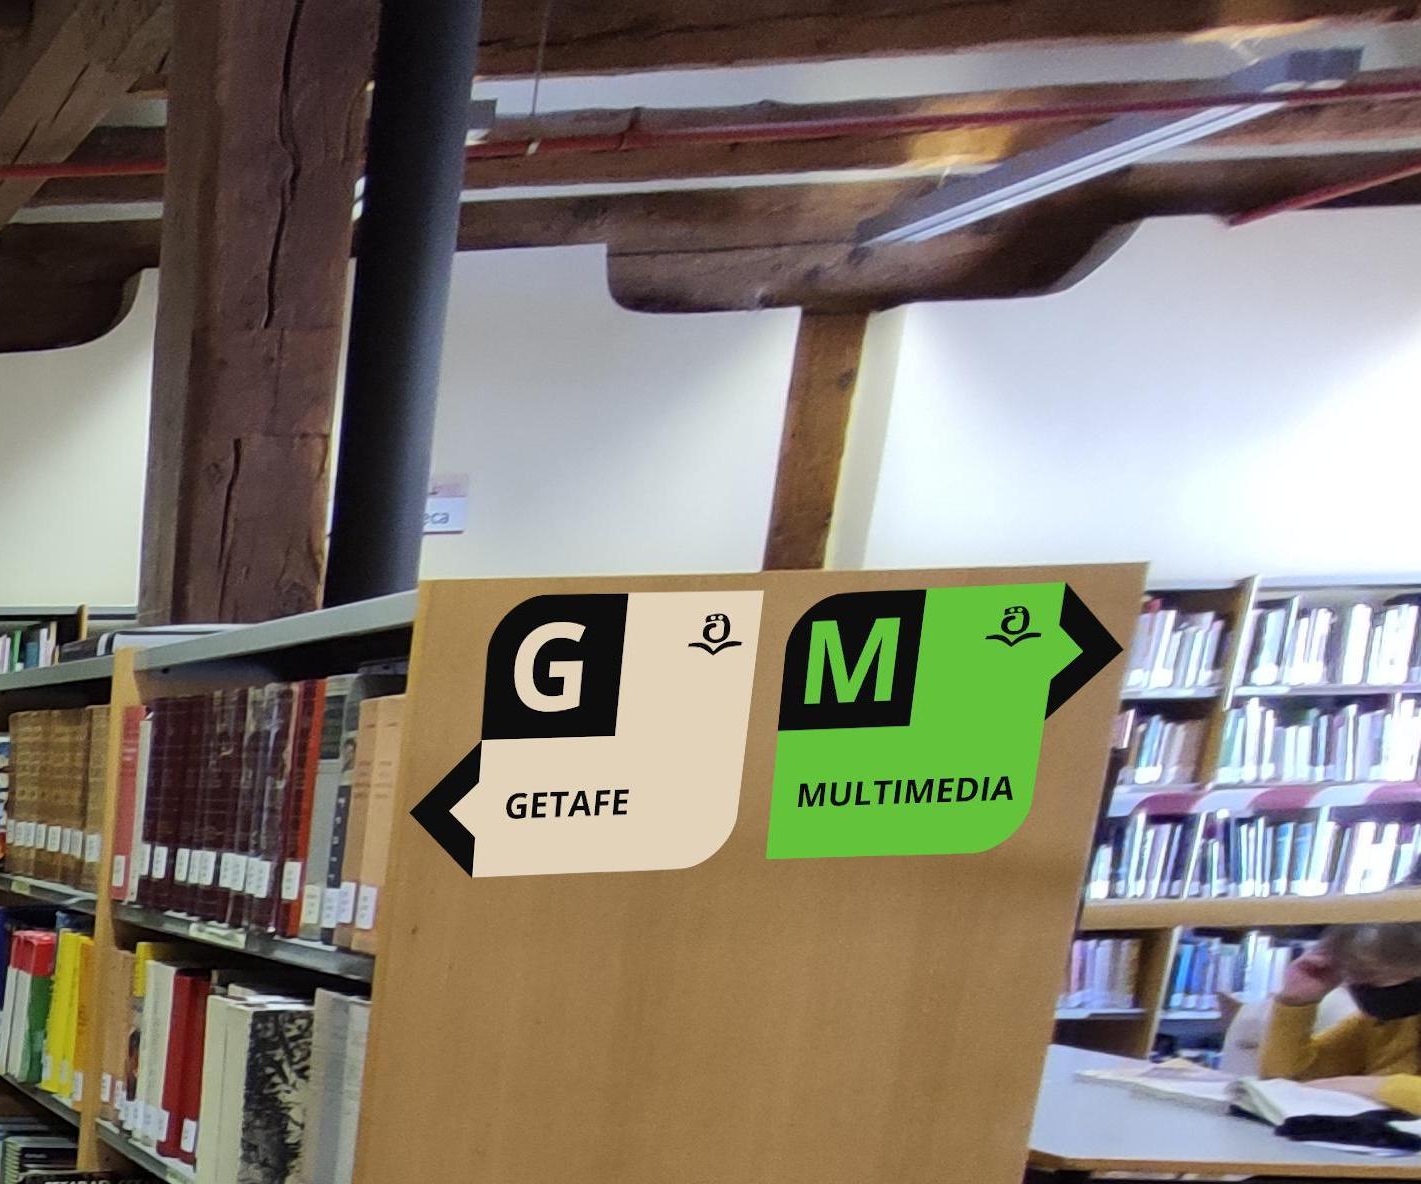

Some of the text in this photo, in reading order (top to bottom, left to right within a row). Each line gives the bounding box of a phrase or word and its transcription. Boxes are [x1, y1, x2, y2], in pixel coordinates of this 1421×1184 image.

[513, 621, 586, 713] G
[803, 617, 901, 705] M
[505, 788, 630, 820] GETAFE
[797, 775, 1014, 808] MULTIMEDIA
